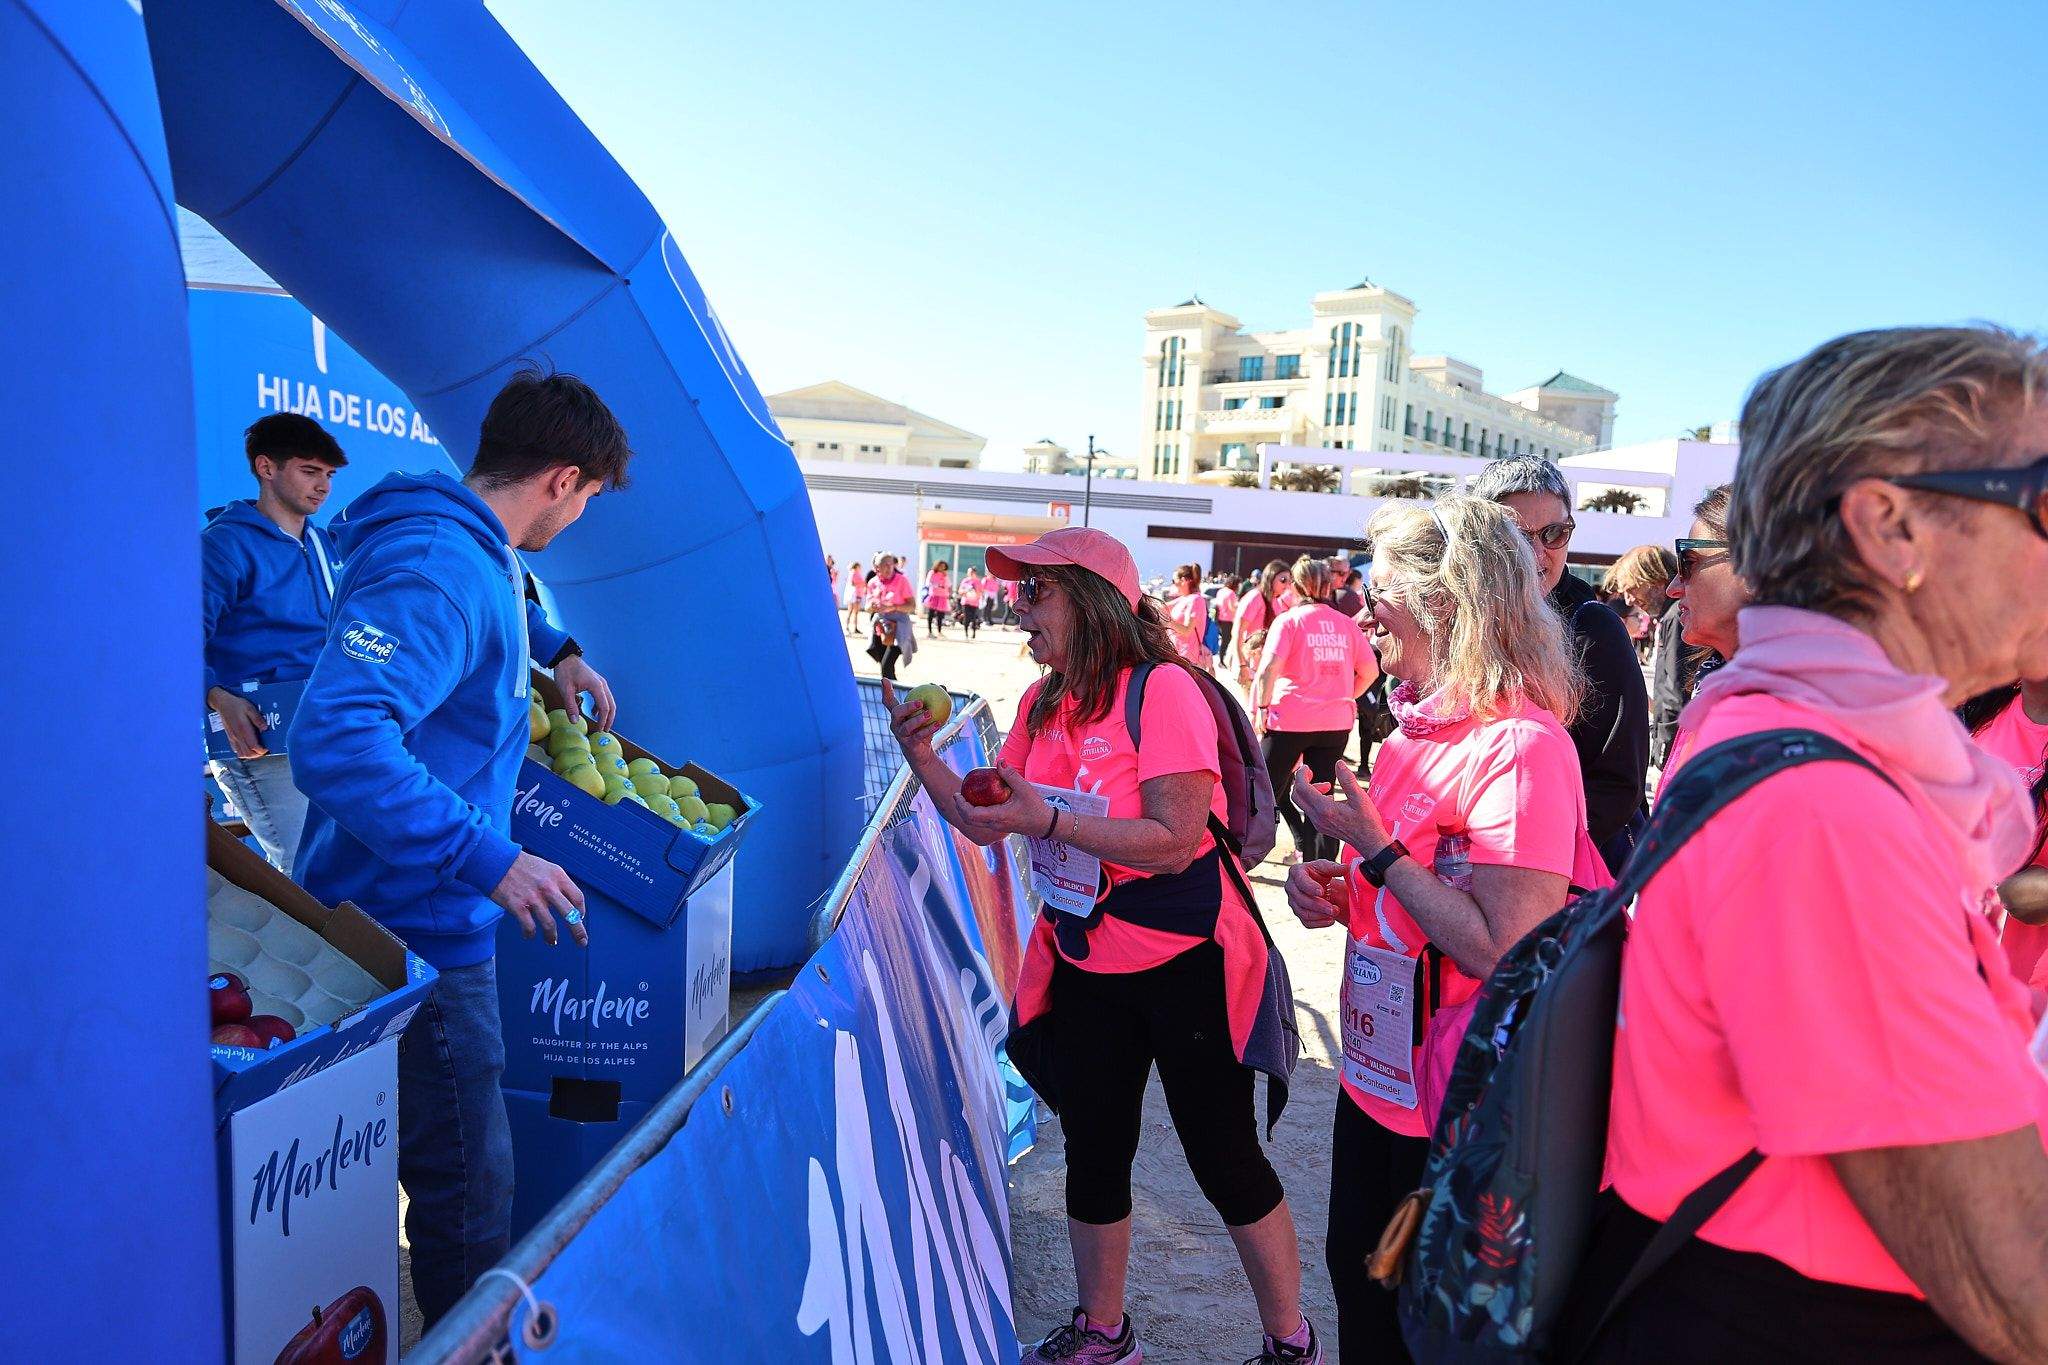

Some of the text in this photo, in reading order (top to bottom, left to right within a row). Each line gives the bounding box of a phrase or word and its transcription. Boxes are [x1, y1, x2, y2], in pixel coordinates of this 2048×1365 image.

[258, 373, 438, 446] HIJA DE LOS AL
[1318, 620, 1335, 634] TU
[1307, 633, 1348, 648] DORSAL
[1314, 647, 1345, 662] SUMA
[573, 824, 641, 866] HIJA DE LOS ALPES
[568, 831, 654, 884] DAUGHTER OF THE ALPS
[530, 977, 650, 1036] Marlene
[532, 1037, 582, 1049] DAUGHTER
[600, 1042, 620, 1050] THE
[622, 1042, 648, 1050] ALPS
[543, 1053, 564, 1063] HIJA
[567, 1055, 579, 1064] DE
[603, 1058, 636, 1066] ALPES
[1363, 1074, 1401, 1096] Santander
[249, 1113, 387, 1237] Marlene
